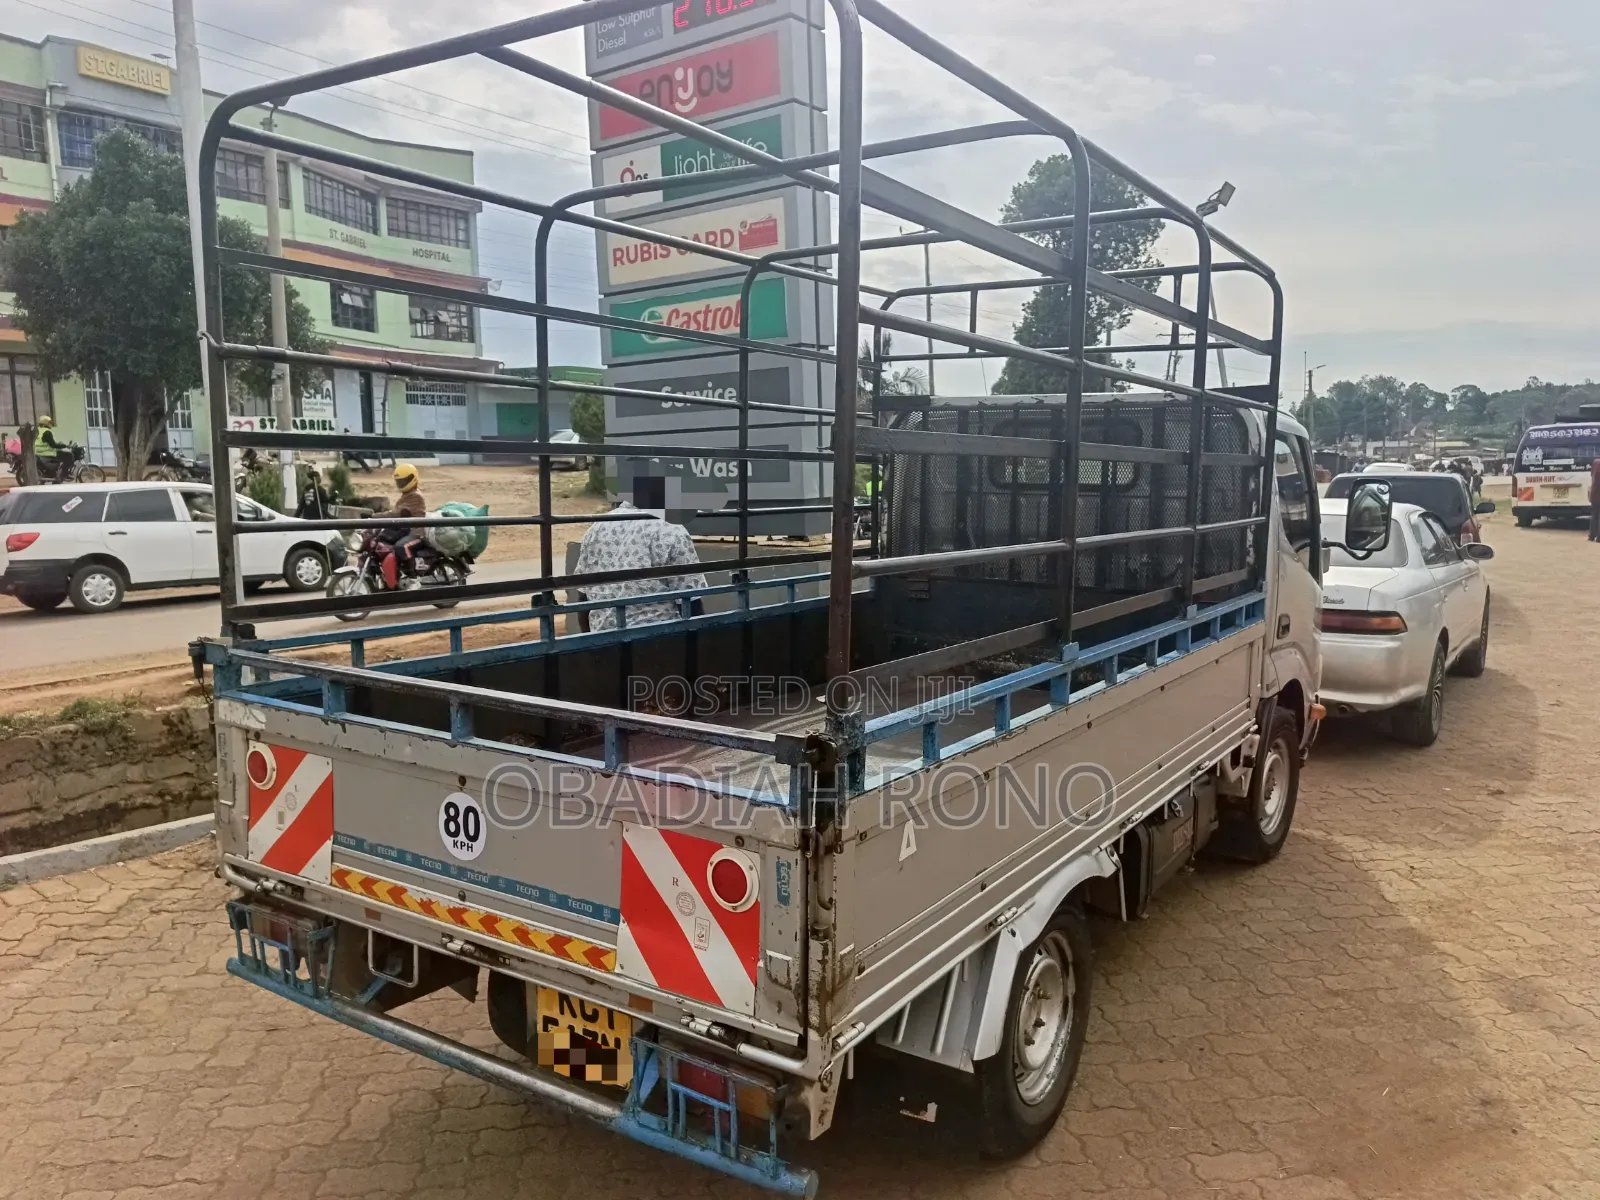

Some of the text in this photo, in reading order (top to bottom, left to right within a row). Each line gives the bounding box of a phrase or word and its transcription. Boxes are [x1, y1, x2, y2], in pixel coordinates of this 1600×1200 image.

[597, 19, 615, 34] Low
[619, 7, 655, 27] Sulphur
[598, 31, 627, 52] Diesel
[341, 232, 367, 249] GABRIEL
[412, 247, 452, 263] HOSPITAL
[666, 298, 742, 332] Castrol
[292, 419, 335, 432] ABRIEL
[443, 801, 481, 843] 80
[452, 839, 474, 853] KPH
[337, 834, 356, 846] TECNO
[377, 846, 398, 858] TECNO
[421, 857, 442, 870] TECNO
[467, 871, 489, 883] TECNO
[516, 883, 540, 897] TECNO
[568, 897, 593, 913] TECNO
[671, 876, 680, 888] R
